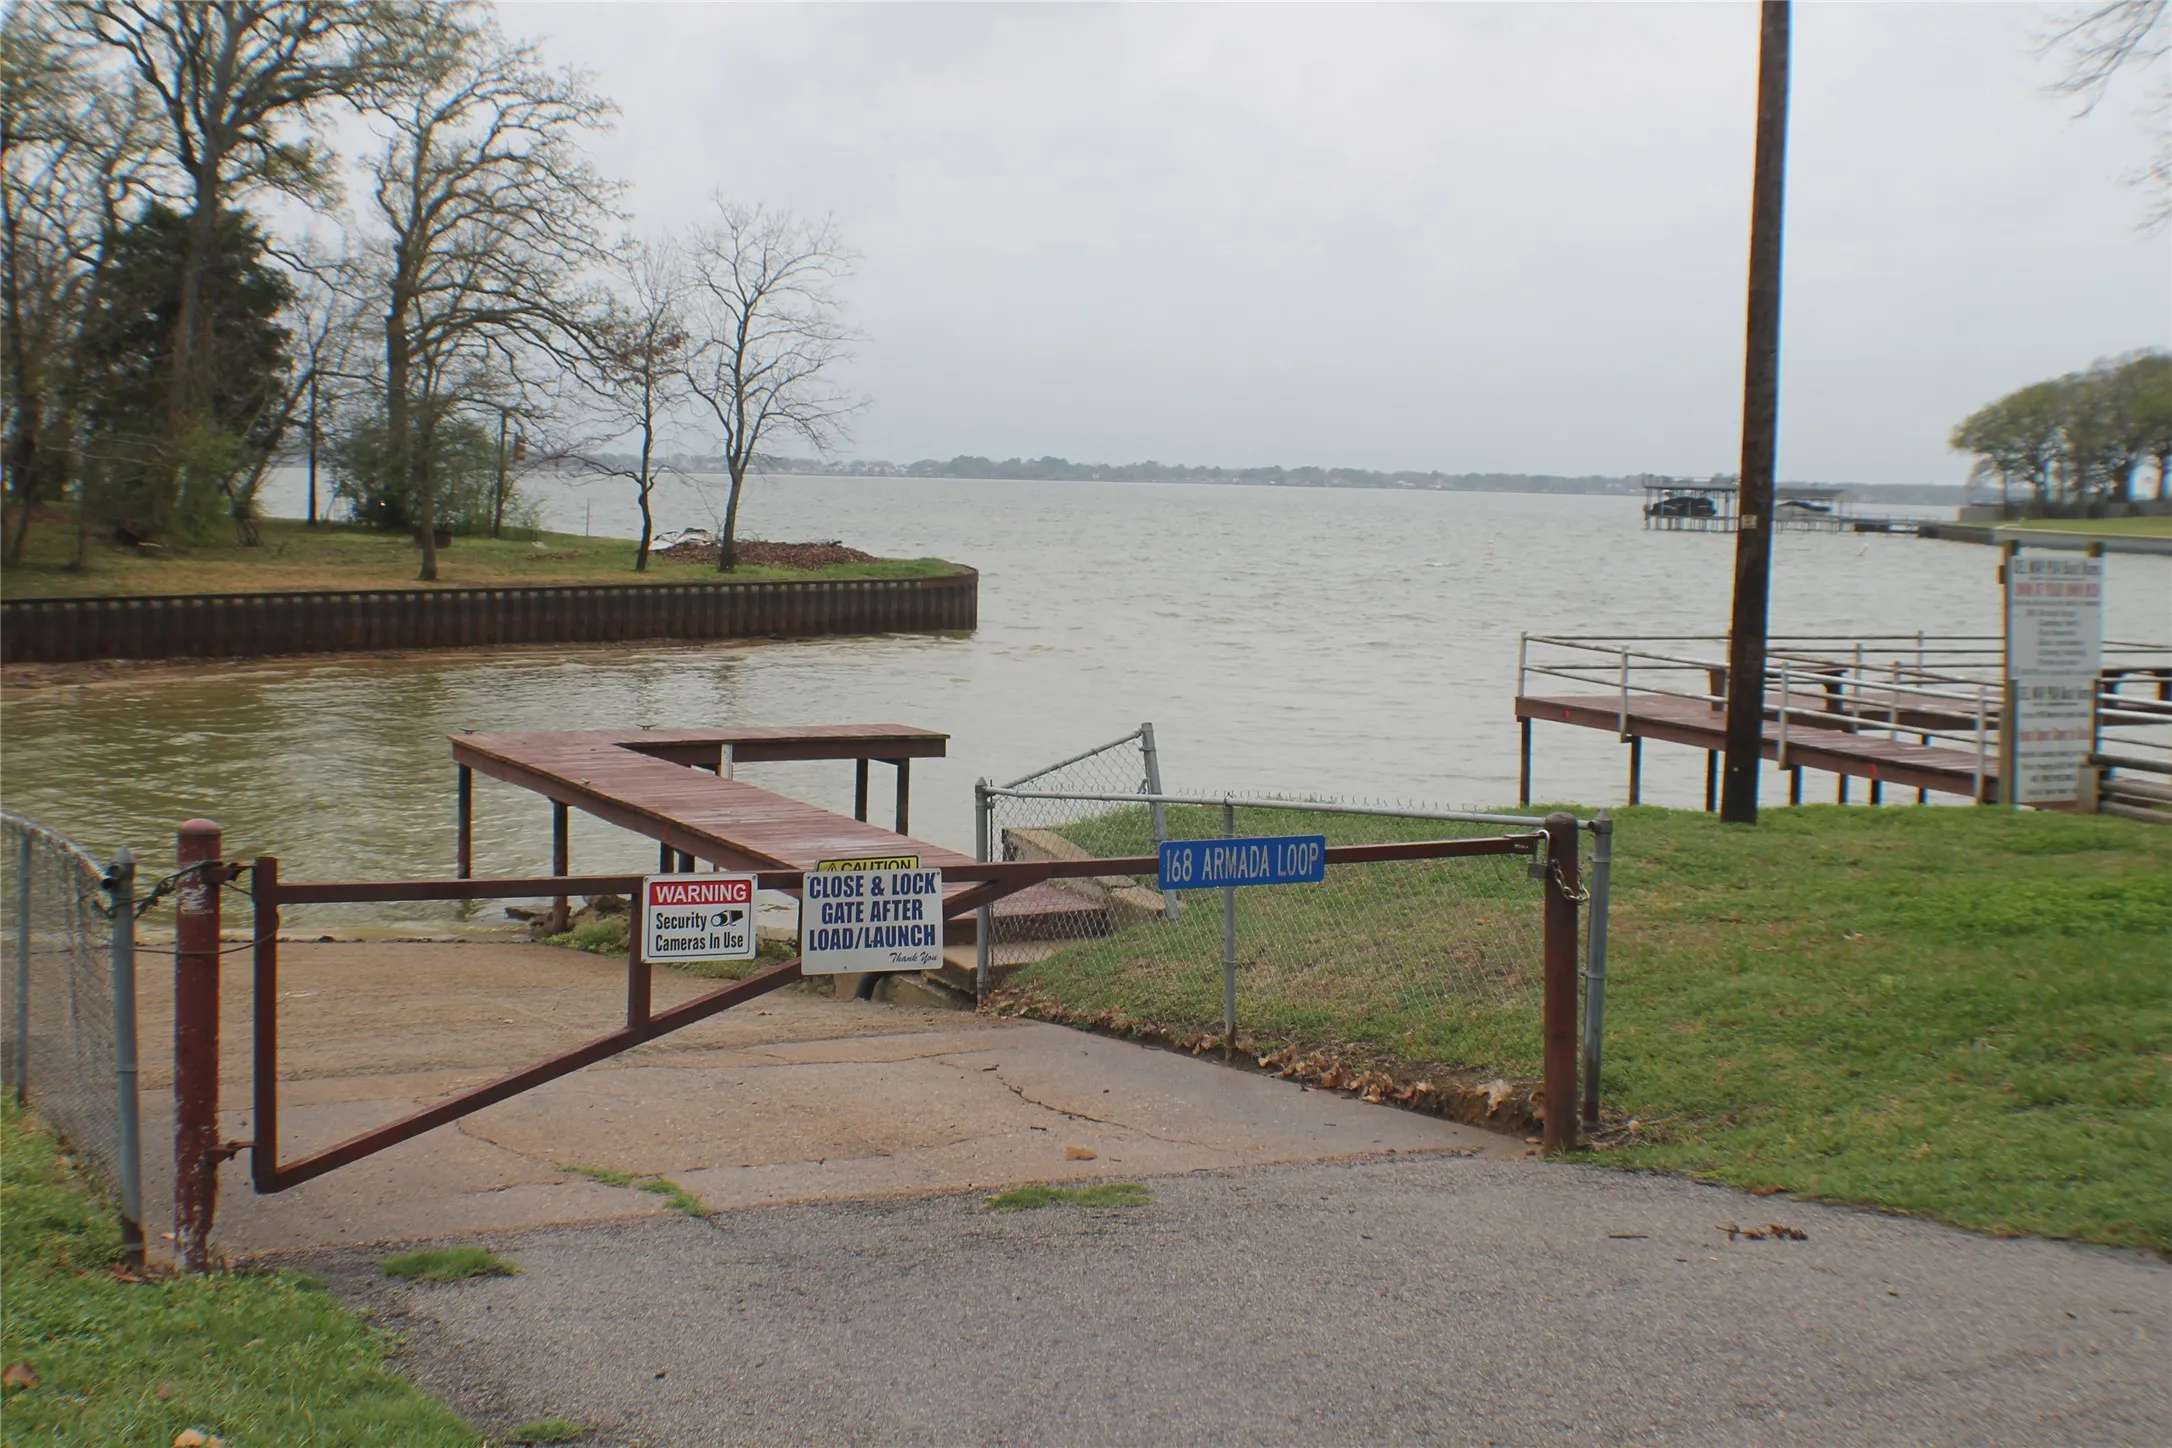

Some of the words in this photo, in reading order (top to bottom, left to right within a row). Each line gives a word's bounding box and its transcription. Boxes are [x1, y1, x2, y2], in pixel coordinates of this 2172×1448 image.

[1165, 848, 1193, 883] 168
[1202, 845, 1270, 881] ARMADA
[1277, 843, 1319, 877] LOOP
[655, 884, 747, 903] WARNING
[809, 875, 864, 899] CLOSE
[871, 876, 885, 896] &
[892, 872, 936, 895] LOCK
[656, 911, 707, 931] Security
[821, 901, 864, 925] GATE
[870, 899, 923, 922] AFTER
[656, 934, 706, 952] Cameras
[709, 932, 720, 949] In
[723, 931, 743, 948] Use
[809, 924, 936, 951] LOAD/LAUNCH
[889, 951, 917, 963] Thank
[919, 951, 937, 964] You
